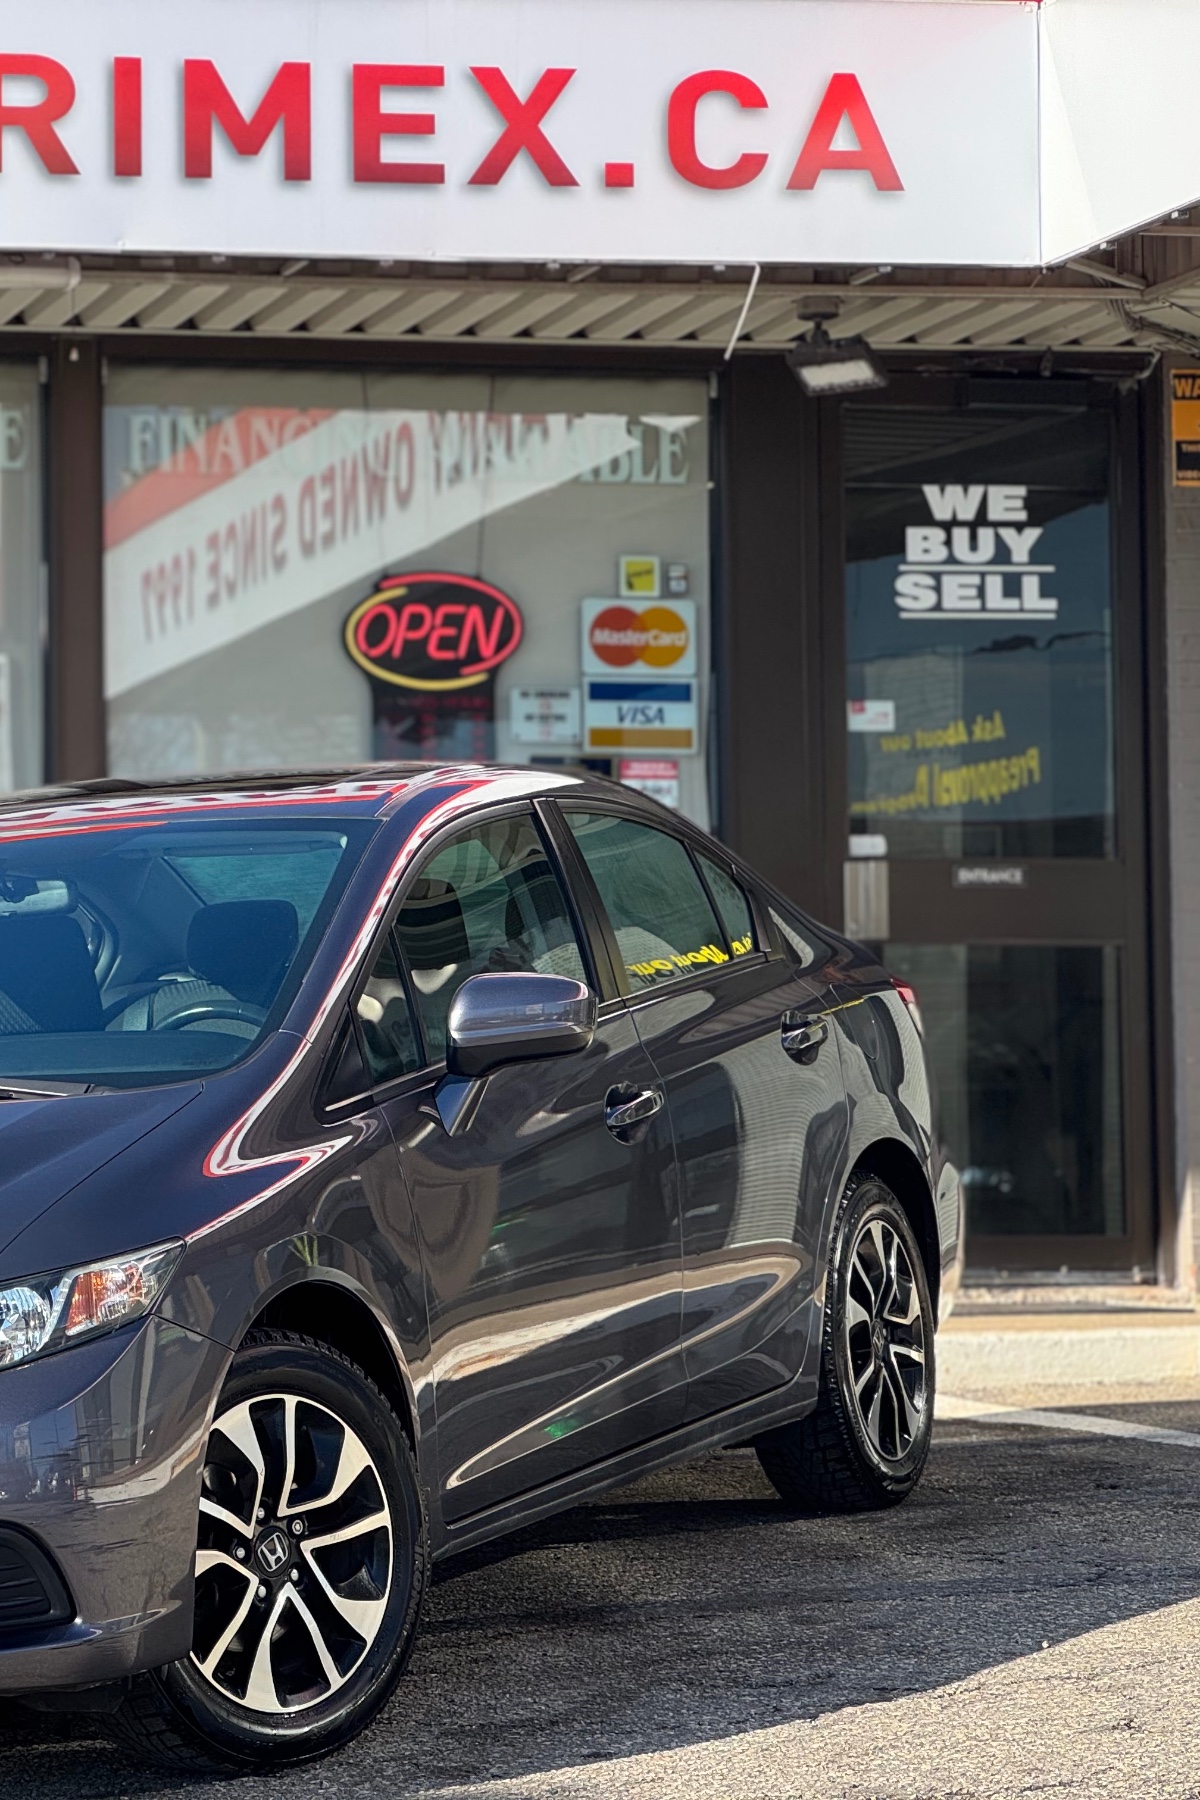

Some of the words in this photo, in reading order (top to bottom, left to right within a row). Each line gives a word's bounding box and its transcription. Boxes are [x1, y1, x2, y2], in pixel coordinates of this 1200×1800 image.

[921, 484, 1028, 521] WE
[905, 526, 1044, 564] BUY
[894, 573, 1058, 611] SELL
[356, 602, 506, 661] OPEN
[592, 627, 687, 648] MasterCard
[617, 705, 666, 725] VISA
